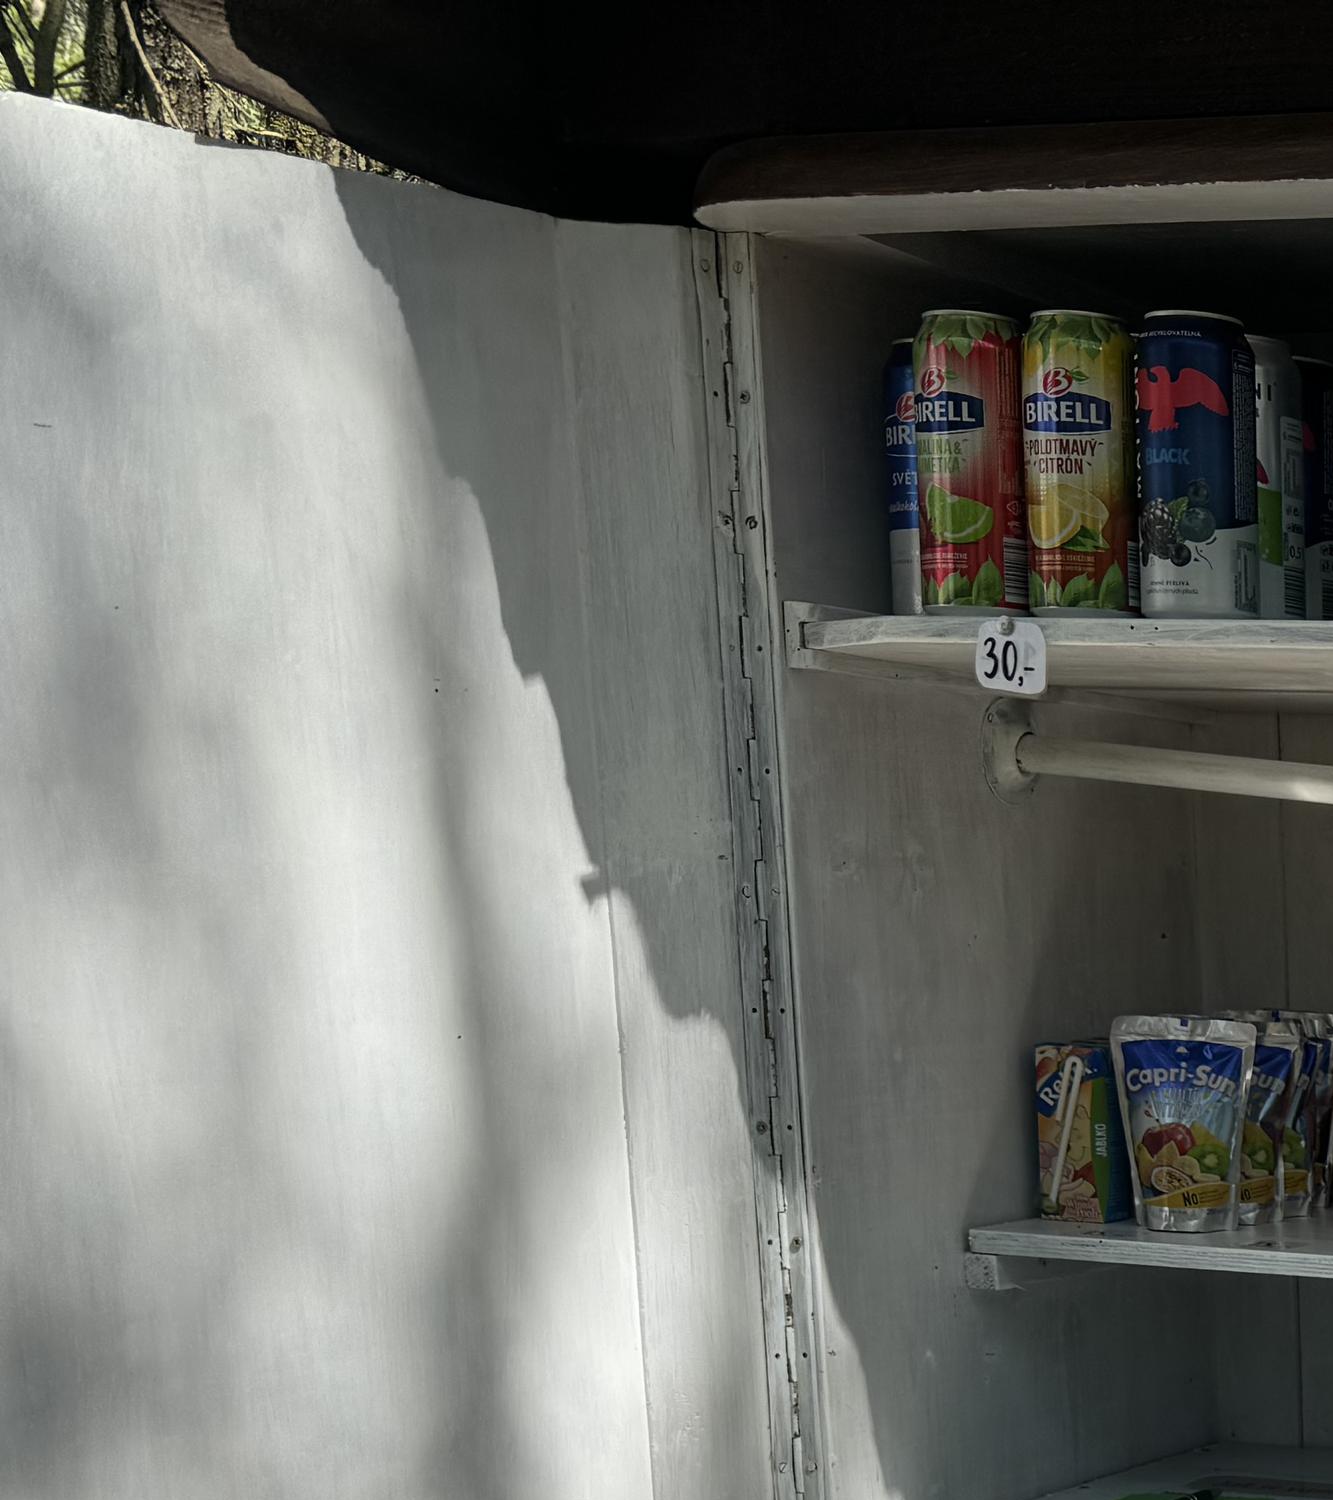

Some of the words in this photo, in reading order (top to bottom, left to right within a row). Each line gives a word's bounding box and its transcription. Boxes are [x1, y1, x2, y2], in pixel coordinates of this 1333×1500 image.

[1025, 401, 1105, 425] BIRELL
[1028, 438, 1098, 457] POLOTMAVÝ
[1146, 448, 1192, 465] BLACK
[1039, 456, 1084, 474] CITRÓN
[983, 637, 1035, 687] 30,-
[1126, 1061, 1238, 1099] Capri-Sun
